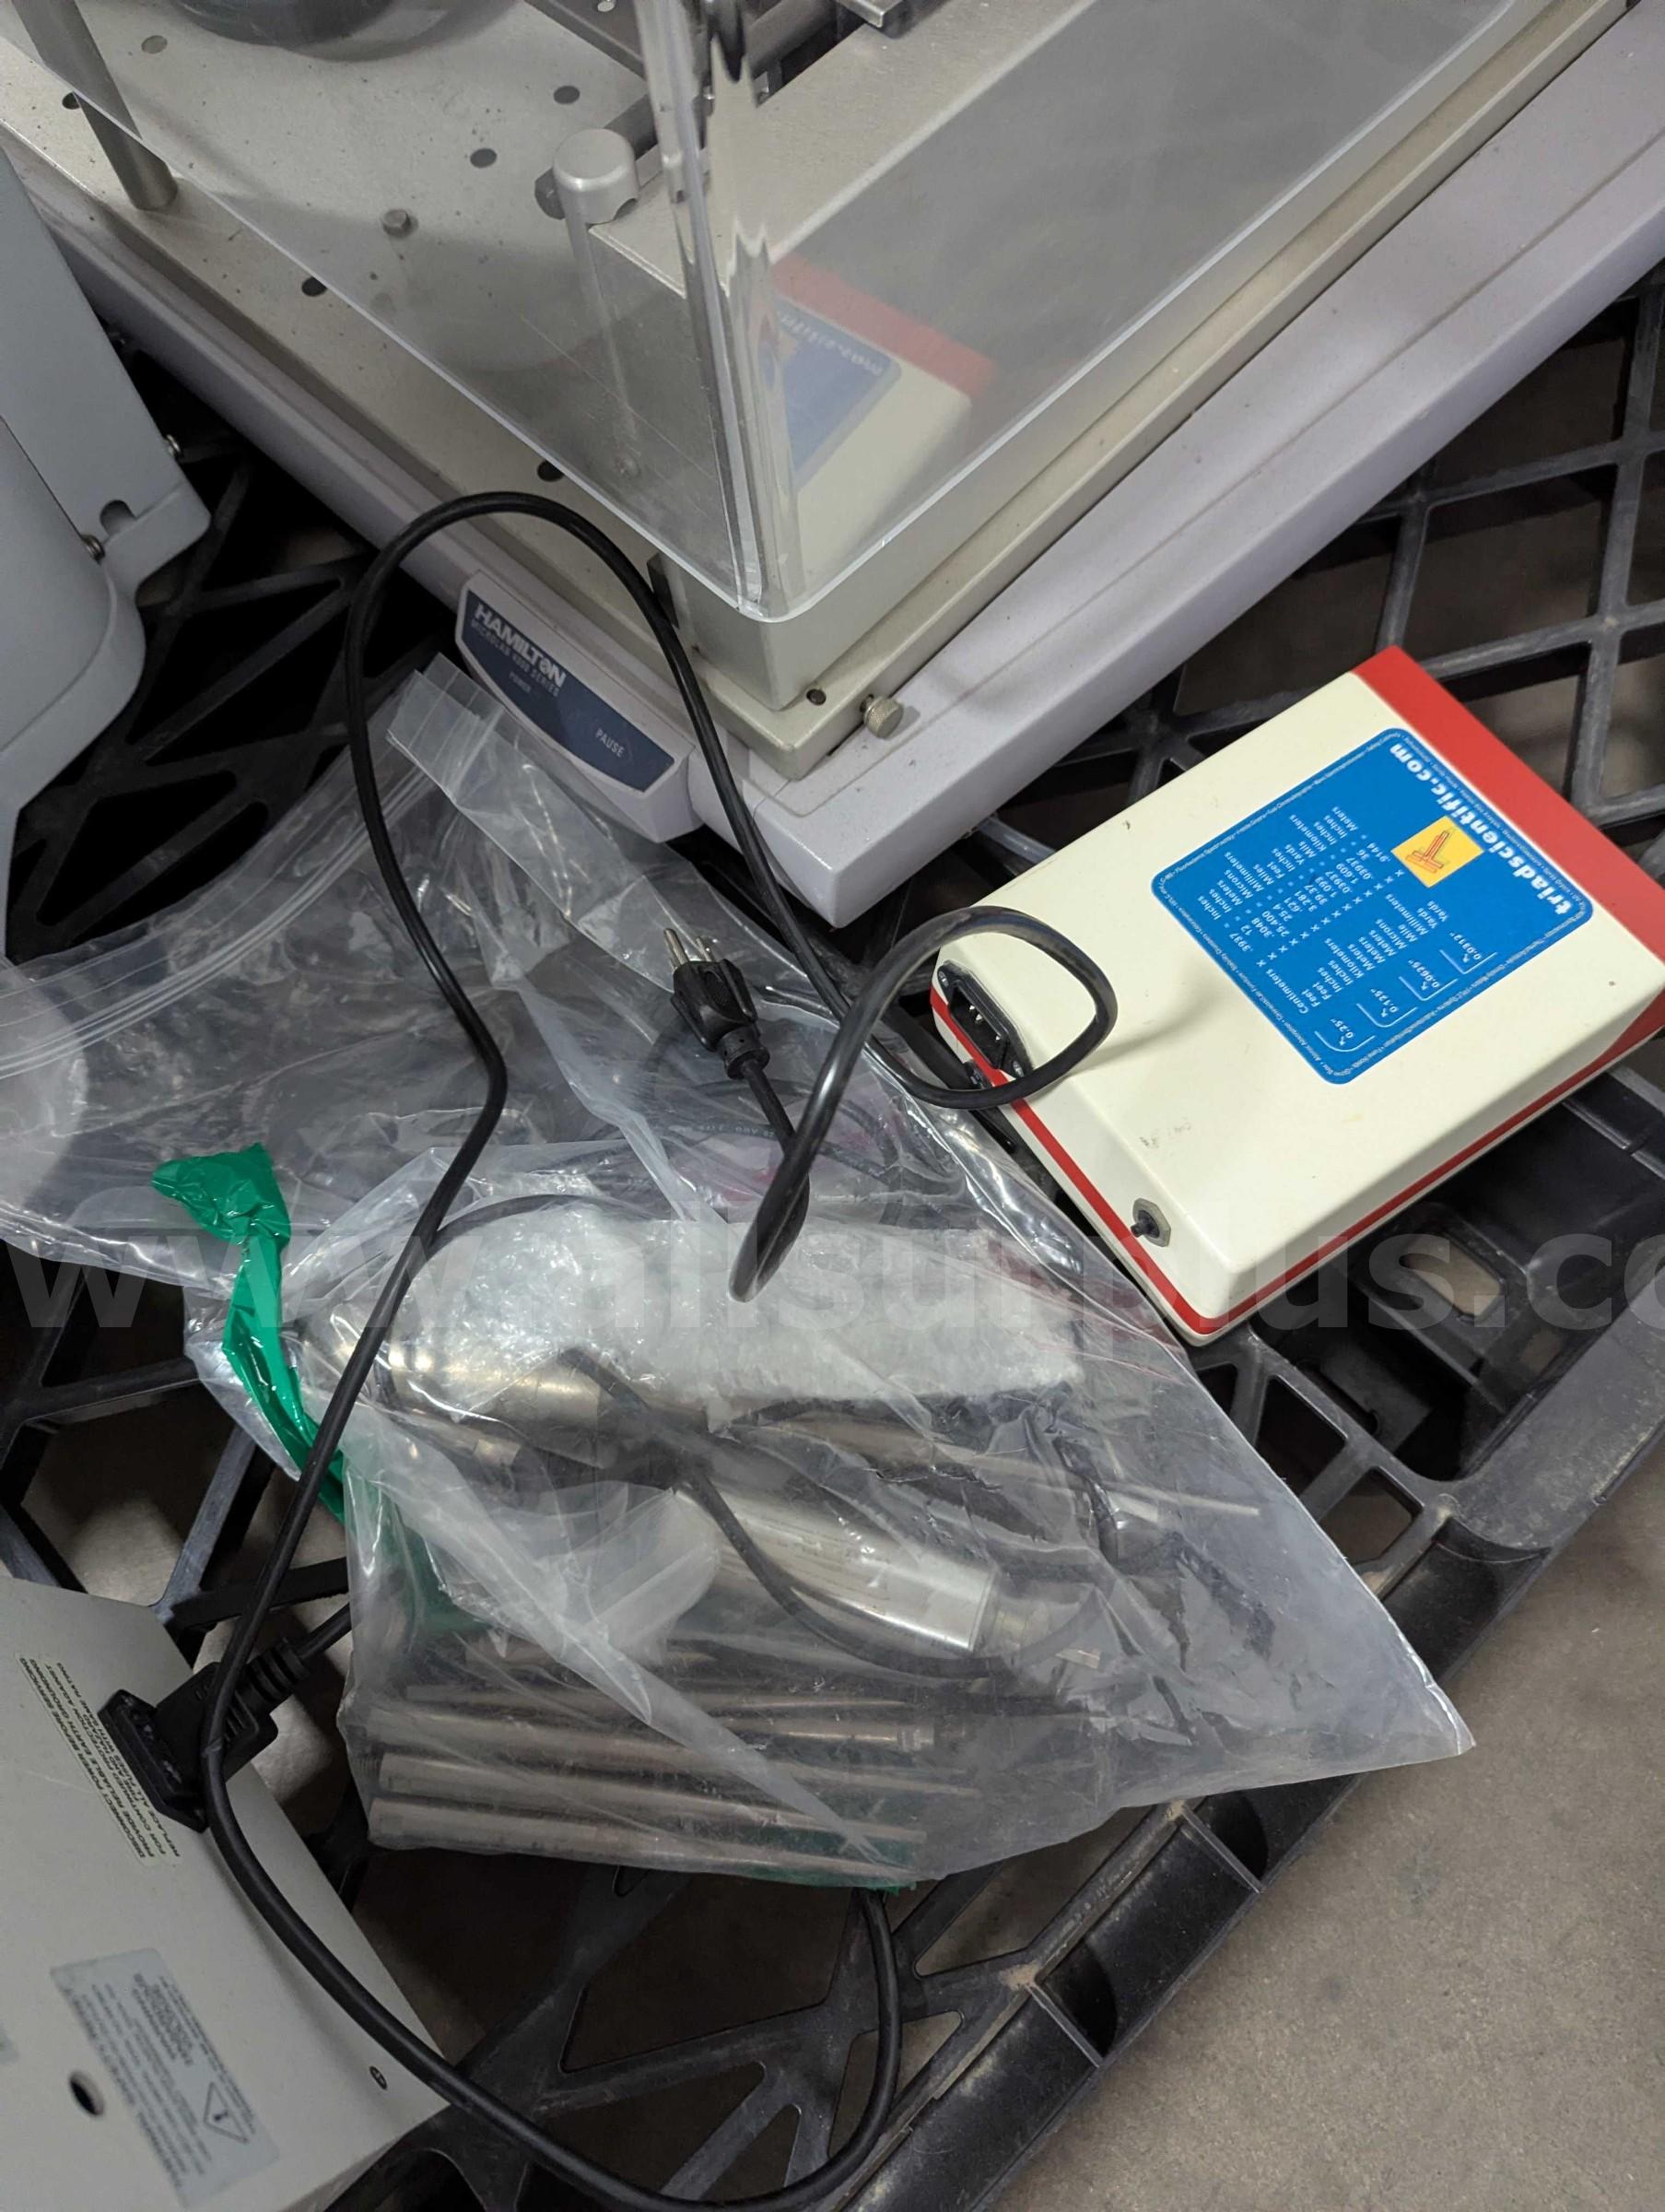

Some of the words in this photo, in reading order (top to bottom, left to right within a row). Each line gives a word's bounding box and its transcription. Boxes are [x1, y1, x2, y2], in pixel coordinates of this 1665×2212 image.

[475, 604, 567, 688] HAMILTON
[596, 727, 626, 759] PAUSE
[1311, 821, 1337, 844] Inches
[1321, 815, 1347, 838] Inches
[1330, 806, 1358, 831] Meters
[1382, 743, 1576, 916] triadscientific.com
[1286, 814, 1327, 852] Kilometers
[1269, 848, 1296, 872] Inches
[1282, 843, 1306, 865] Yards
[1296, 840, 1317, 858] Mils
[1355, 848, 1369, 860] 36
[1222, 851, 1264, 892] Millimeters
[1250, 864, 1274, 885] Miles
[1265, 861, 1284, 878] Feet
[1214, 879, 1242, 906] Meters
[1222, 869, 1253, 899] Microns
[1195, 895, 1221, 920] Inches
[1206, 888, 1232, 912] Inches
[1272, 902, 1292, 921] 25.4
[1382, 893, 1428, 935] Millimeters
[1425, 900, 1449, 922] Yards
[1240, 924, 1253, 935] 12
[1414, 907, 1438, 928] Yards
[1366, 929, 1396, 957] Meters
[1373, 918, 1407, 949] Microns
[1396, 924, 1417, 943] Mile
[1321, 937, 1365, 978] Kilometers
[1345, 943, 1375, 971] Meters
[1355, 935, 1386, 964] Meters
[1315, 966, 1343, 993] Inches
[1326, 959, 1354, 985] Inches
[1263, 968, 1310, 1014] Centimeters
[1300, 988, 1320, 1006] Feet
[1311, 981, 1331, 1000] Feet
[18, 1657, 55, 1709] SERVICING
[28, 1658, 70, 1718] GROUNDING
[43, 1663, 76, 1706] AGAINST
[54, 1662, 82, 1698] RATING
[51, 1711, 80, 1750] BEFORE
[65, 1720, 92, 1755] EARTH
[71, 1707, 114, 1770] PROTECTION
[81, 1713, 111, 1754] HAZARD
[96, 1728, 116, 1752] WITH
[76, 1753, 104, 1789] POWER
[107, 1756, 125, 1777] AND
[88, 1758, 125, 1807] RELIABLE
[111, 1771, 152, 1830] CONTINUED
[100, 1793, 147, 1857] DISCONNECT
[121, 1810, 155, 1857] PROVIDE
[147, 1809, 182, 1856] REPLACE
